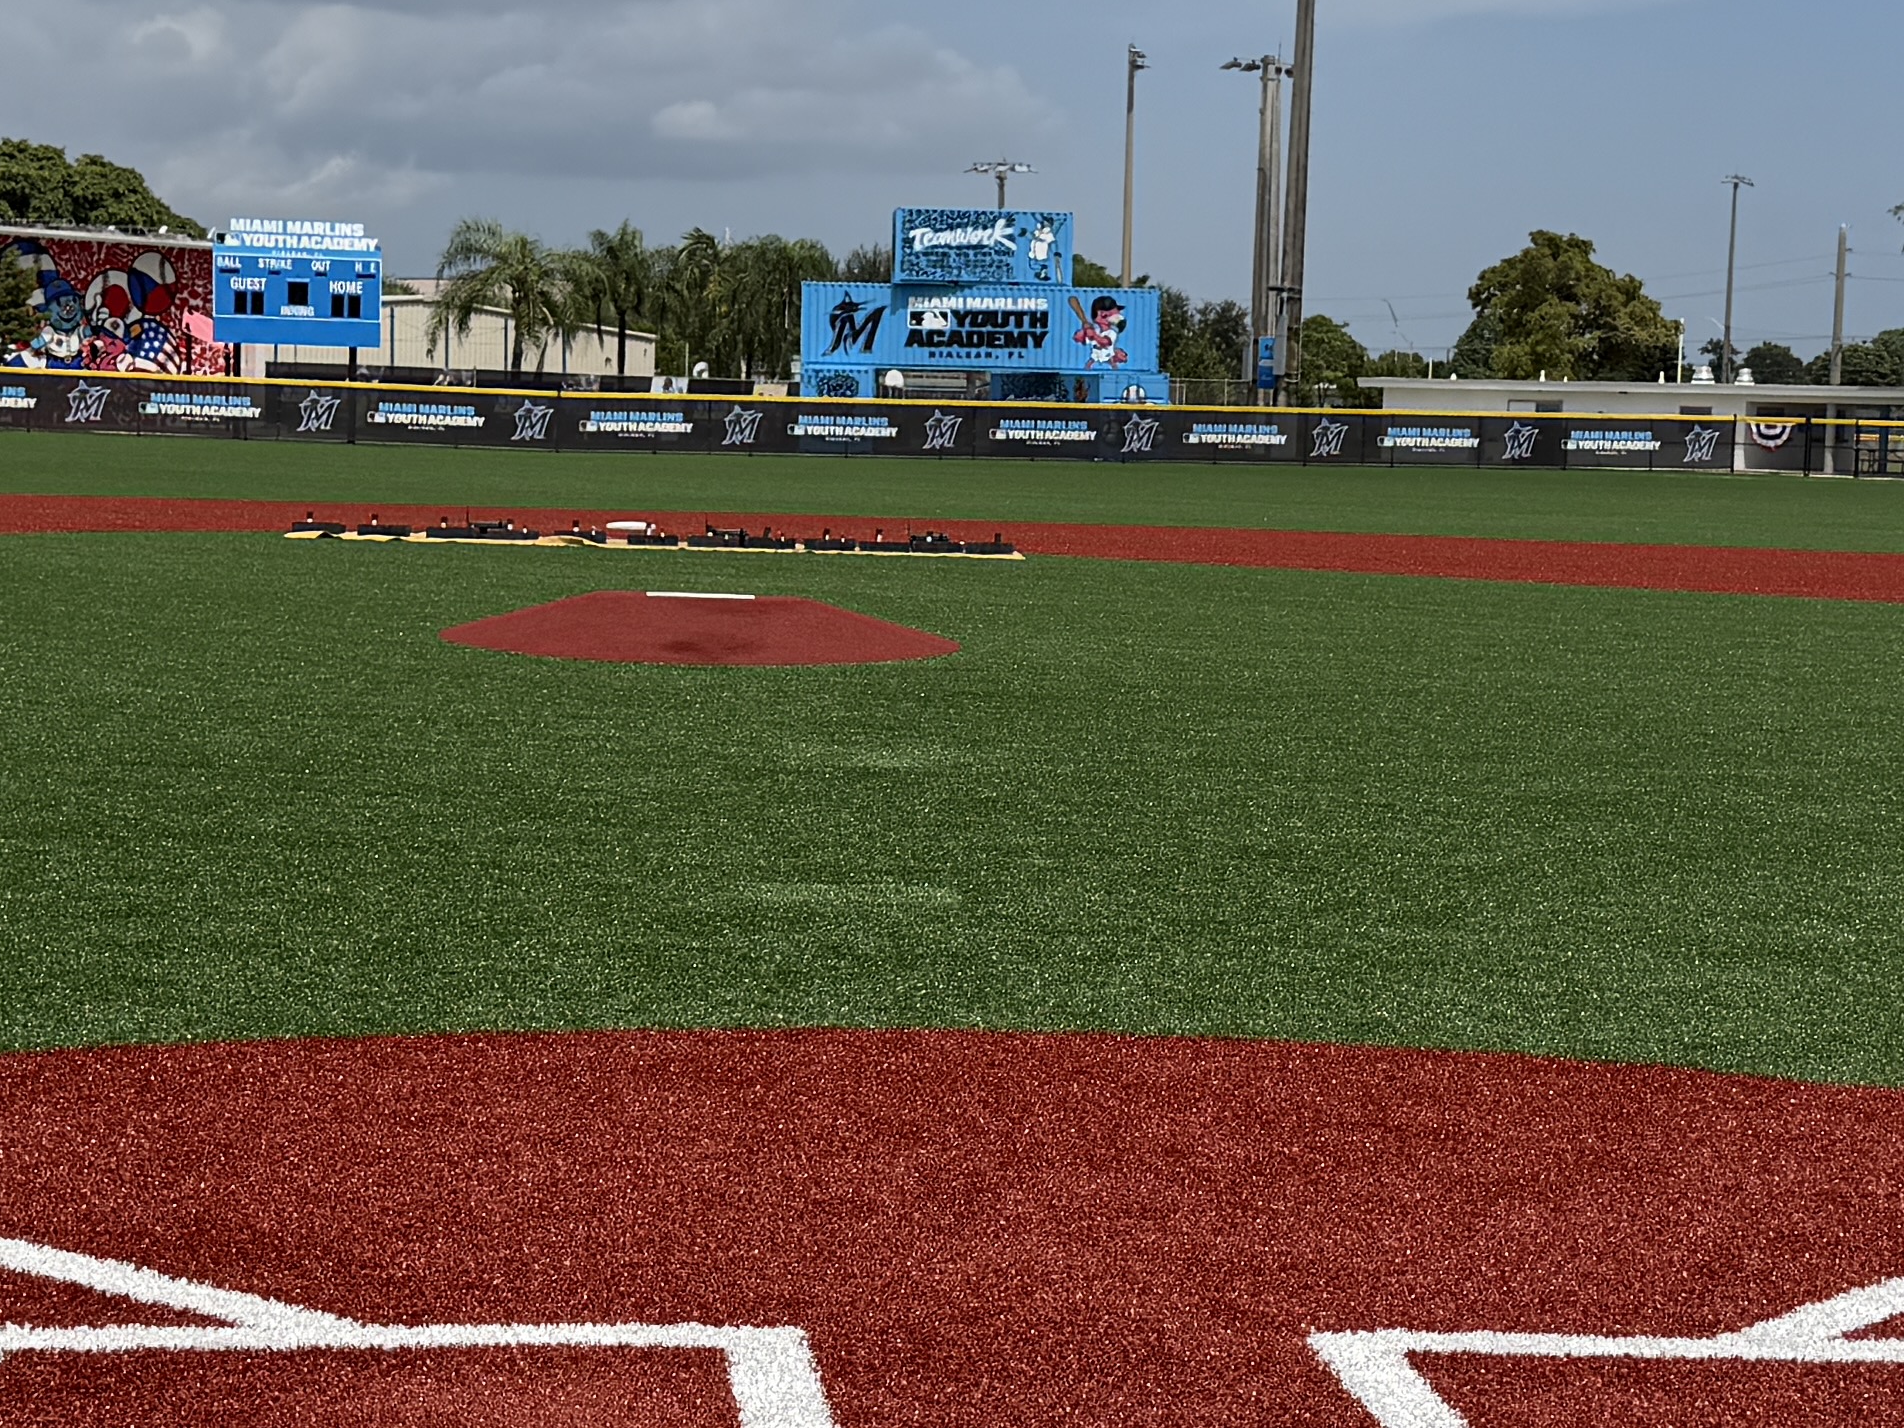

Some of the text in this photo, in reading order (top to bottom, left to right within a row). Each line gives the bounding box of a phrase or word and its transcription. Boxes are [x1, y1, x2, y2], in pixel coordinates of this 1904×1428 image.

[230, 218, 364, 237] MIAMI MARLINS
[217, 256, 242, 268] BALL
[258, 258, 292, 270] STRIKE
[311, 260, 331, 272] OUT
[230, 276, 267, 290] GUEST
[329, 280, 363, 294] HOME
[908, 297, 1048, 310] MIAMI MARLINS
[951, 311, 1049, 329] YOUTH
[904, 329, 1049, 348] ACADEMY
[1008, 351, 1025, 359] FL
[150, 392, 251, 407] MIAMI MARLINS
[379, 402, 475, 416] MIAMI MARLINS
[590, 410, 684, 422] MIAMI MARLINS
[798, 414, 888, 427] MIAMI MARLINS
